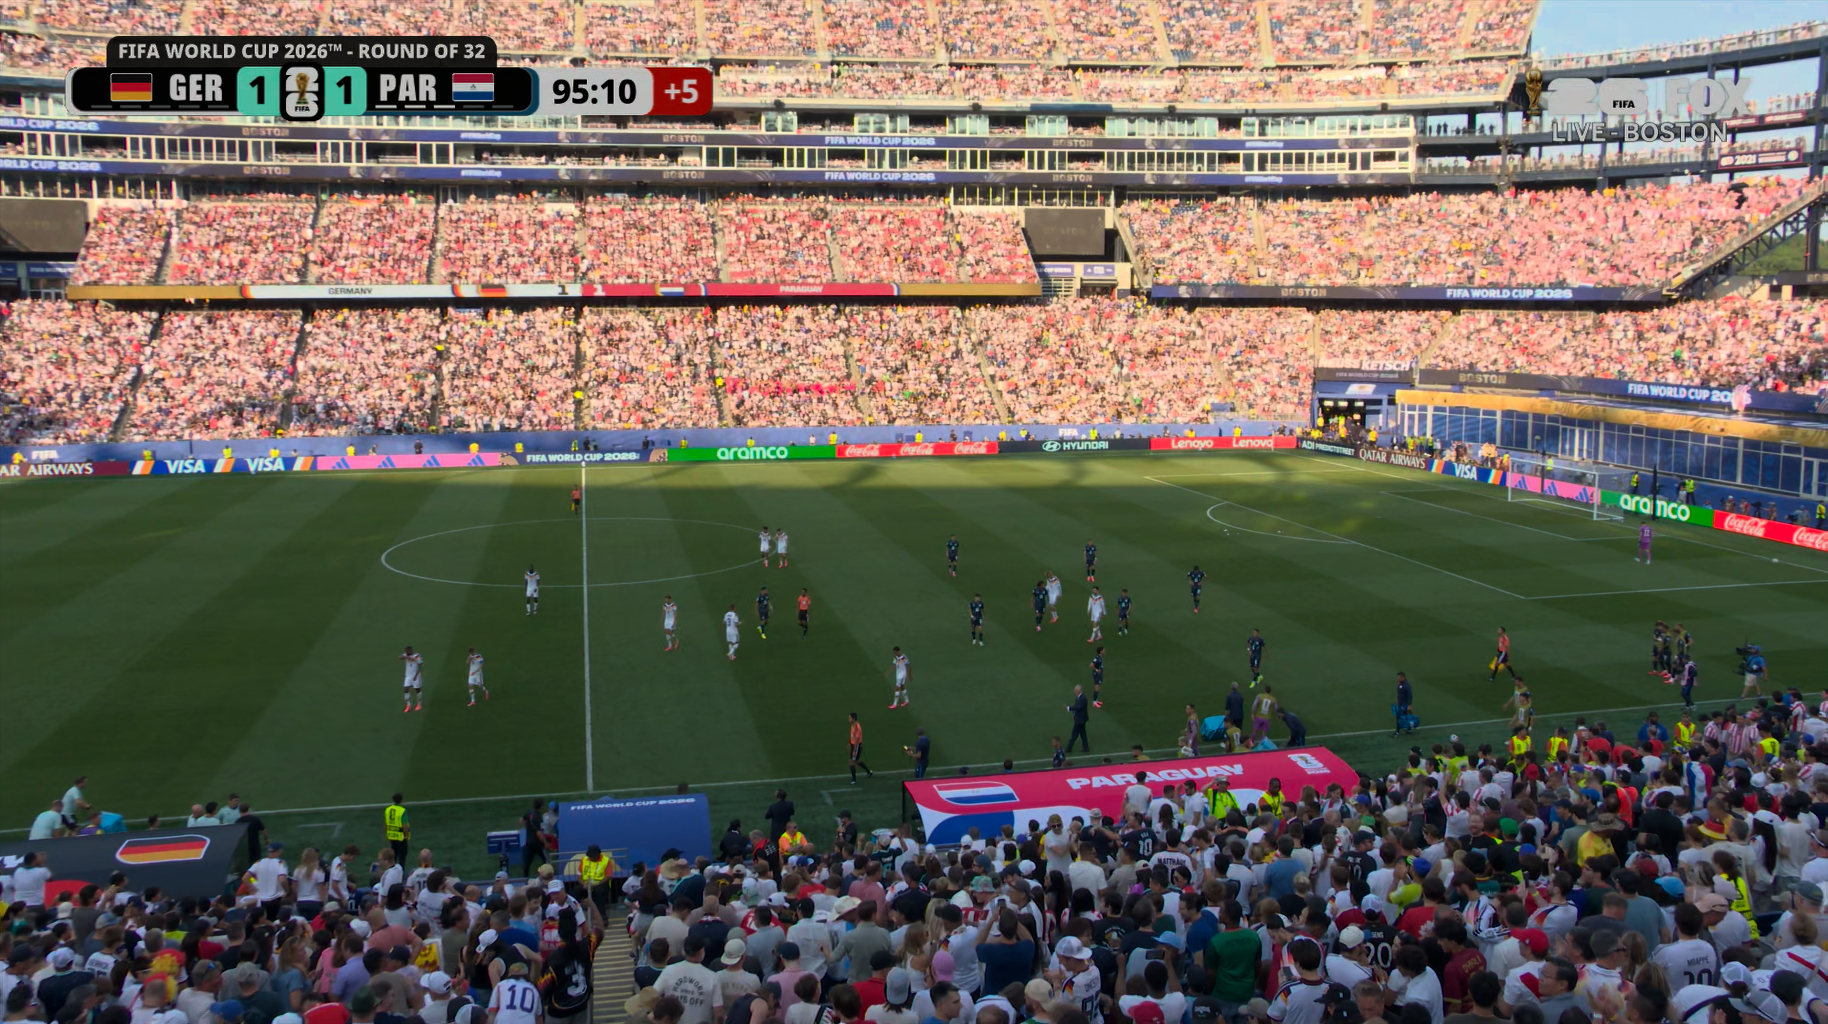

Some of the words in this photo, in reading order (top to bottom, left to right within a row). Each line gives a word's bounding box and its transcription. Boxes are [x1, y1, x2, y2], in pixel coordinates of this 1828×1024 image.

[28, 120, 54, 129] CUP
[55, 121, 99, 131] 2026
[242, 127, 289, 137] BOSTON
[662, 134, 705, 143] BOSTON
[825, 136, 847, 145] FIFA
[848, 136, 881, 146] WORLD
[883, 136, 901, 146] CUP
[902, 136, 936, 146] 2026
[1052, 139, 1094, 148] BOSTON
[31, 160, 56, 170] CUP
[58, 161, 101, 171] 2026
[243, 166, 291, 176] BOSTON
[662, 171, 705, 180] BOSTON
[825, 171, 847, 180] FIFA
[848, 171, 881, 181] WORLD
[883, 172, 901, 181] CUP
[902, 172, 936, 182] 2026
[1052, 174, 1094, 183] BOSTON
[328, 287, 373, 295] GERMANY
[558, 285, 569, 295] 1
[593, 284, 606, 295] 1
[779, 285, 824, 294] PARAGUAY
[1281, 288, 1327, 297] BOSTON
[1446, 289, 1469, 298] FIFA
[1471, 289, 1511, 299] WORLD
[1513, 289, 1533, 298] CUP
[1534, 289, 1573, 299] 2026
[1361, 358, 1410, 371] KETSCH
[1459, 373, 1507, 384] BOSTON
[1628, 383, 1649, 396] FIFA
[1650, 385, 1687, 399] WORLD
[1688, 388, 1710, 400] CUP
[1058, 428, 1079, 437] FIFA
[1062, 440, 1109, 451] HYUNDAI
[1171, 437, 1214, 449] Lenovo
[1232, 436, 1273, 448] Lenovo
[1301, 440, 1315, 450] ADI
[32, 450, 58, 459] FIFA
[526, 454, 547, 463] FIFA
[548, 453, 583, 463] WORLD
[584, 452, 603, 462] CUP
[717, 445, 788, 460] aramco
[1359, 448, 1387, 463] QATAR
[1389, 453, 1426, 469] AIRWAYS
[27, 462, 94, 476] AIRWAYS
[164, 459, 206, 473] VISA
[247, 457, 285, 472] VISA
[1454, 462, 1478, 480] VISA
[1620, 494, 1691, 521] aramco
[1066, 764, 1244, 790] PARAGUAY
[595, 801, 634, 809] WORLD
[506, 984, 535, 1014] 10
